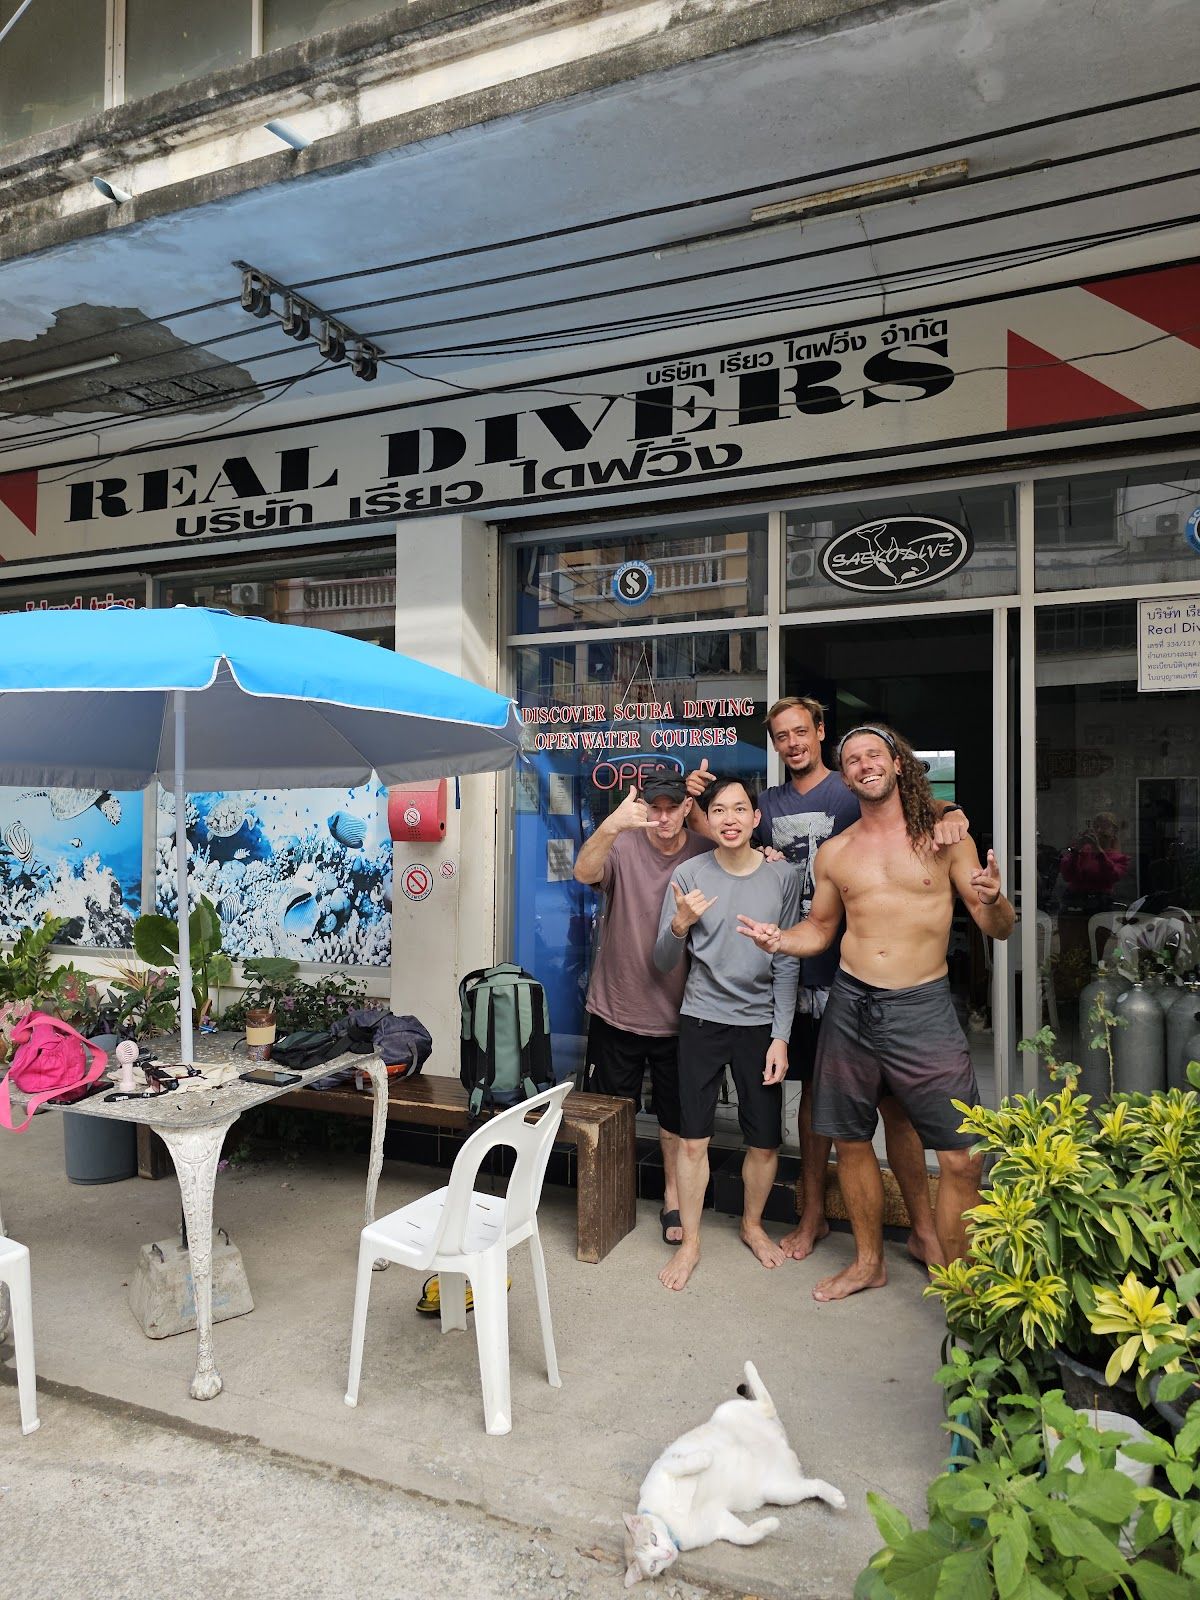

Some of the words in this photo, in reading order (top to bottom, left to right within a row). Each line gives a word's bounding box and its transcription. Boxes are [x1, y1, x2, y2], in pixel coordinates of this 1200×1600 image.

[646, 361, 707, 385] บริษัท
[720, 351, 774, 374] เรียว
[880, 318, 948, 346] จำกัด
[64, 446, 338, 523] REAL
[379, 338, 955, 480] DIVERS
[176, 498, 314, 537] บริษัท
[349, 481, 484, 519] เรียว
[26, 596, 83, 611] Ild
[1147, 605, 1181, 620] บริษัท
[1147, 623, 1177, 636] Real
[522, 705, 606, 724] DISCOVER
[613, 701, 674, 721] SCUBA
[683, 697, 754, 719] DIVING
[650, 727, 738, 748] COURSES
[592, 762, 679, 791] OPE
